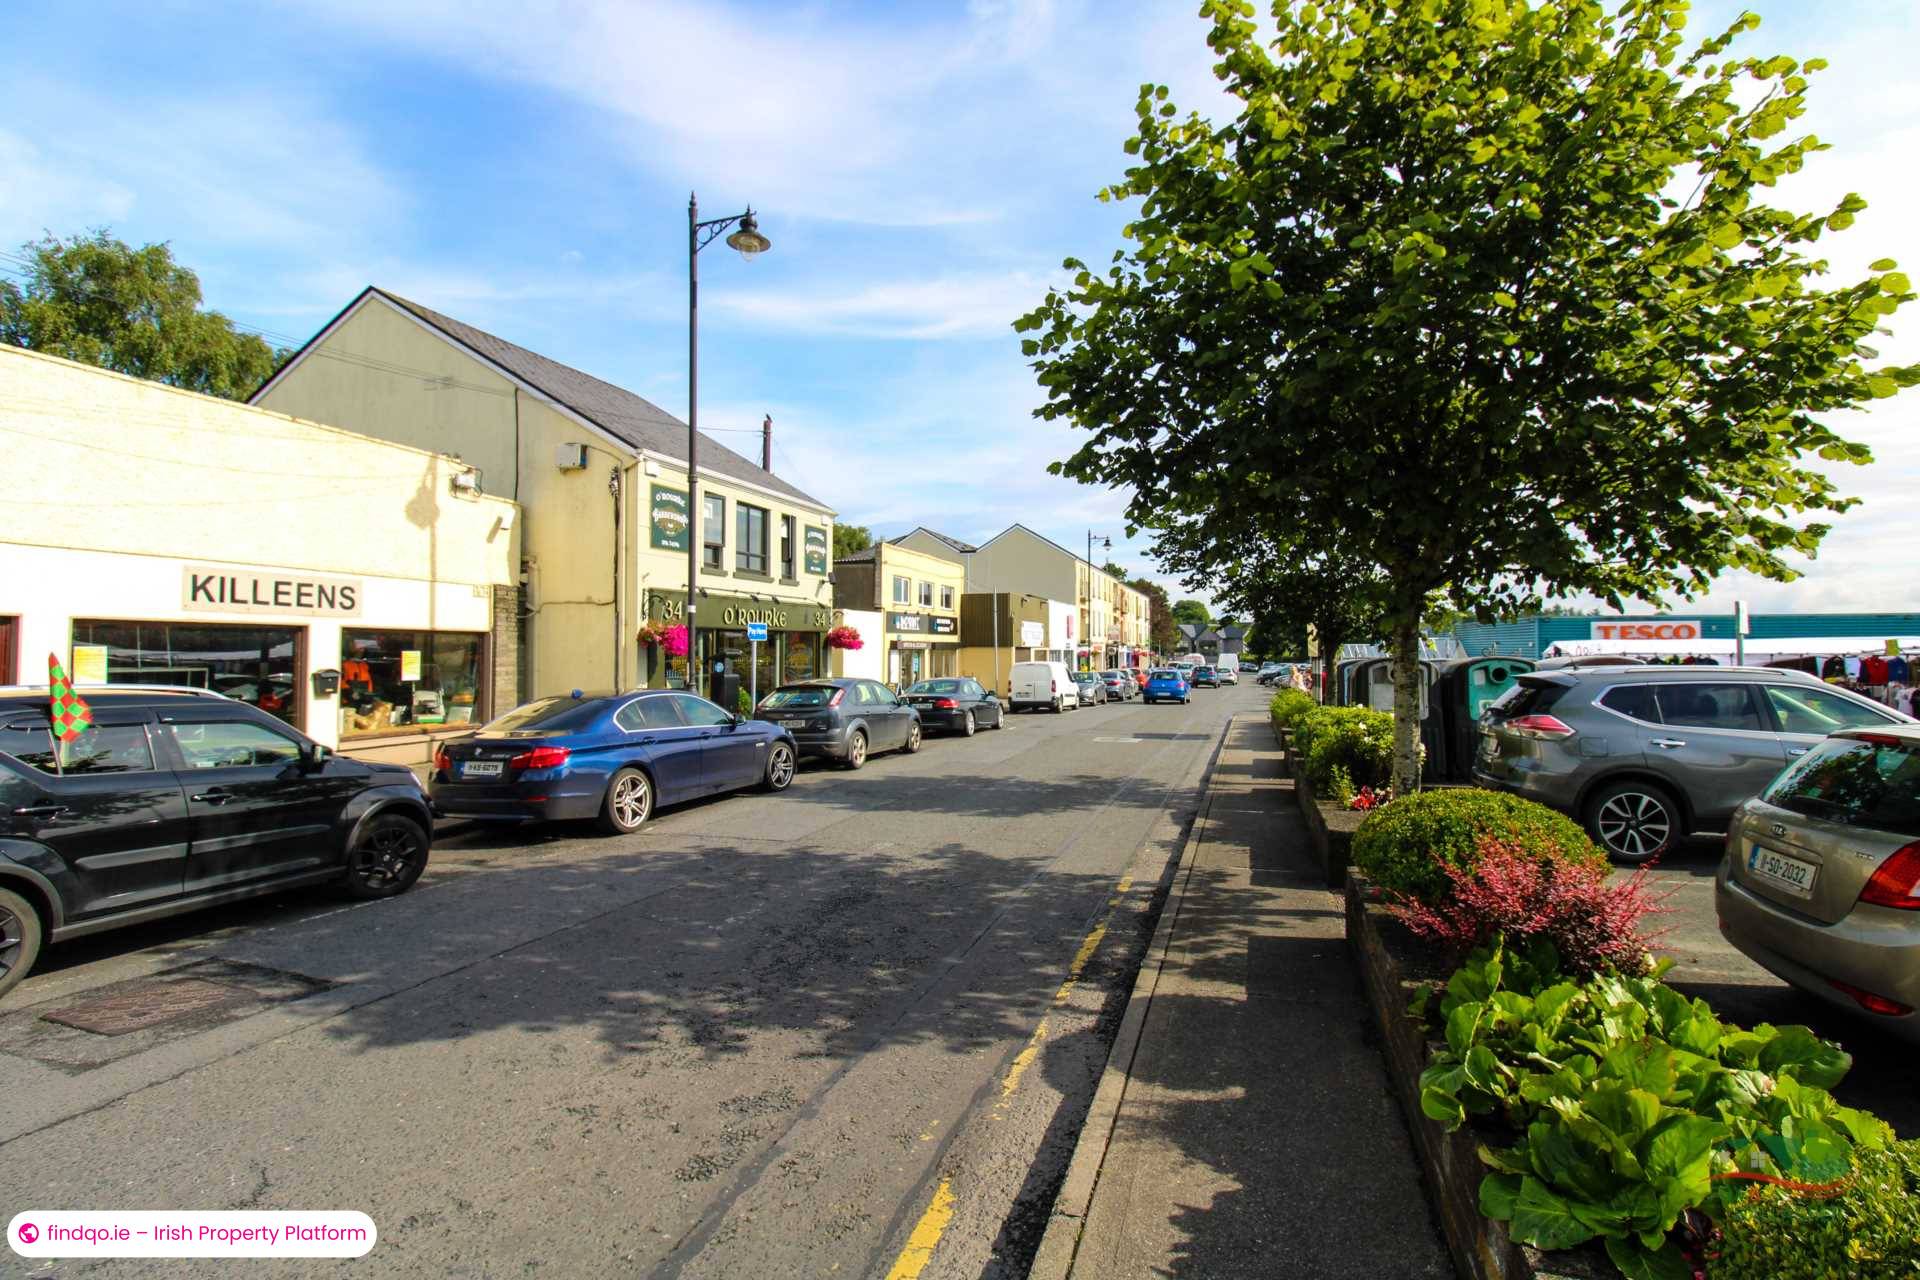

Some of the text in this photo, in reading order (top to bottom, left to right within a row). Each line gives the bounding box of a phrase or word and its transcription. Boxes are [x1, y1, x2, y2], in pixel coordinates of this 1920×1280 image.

[191, 574, 356, 610] KILLEENS
[664, 600, 826, 628] 34 O'ROURKE 34
[1597, 624, 1697, 640] TESCO
